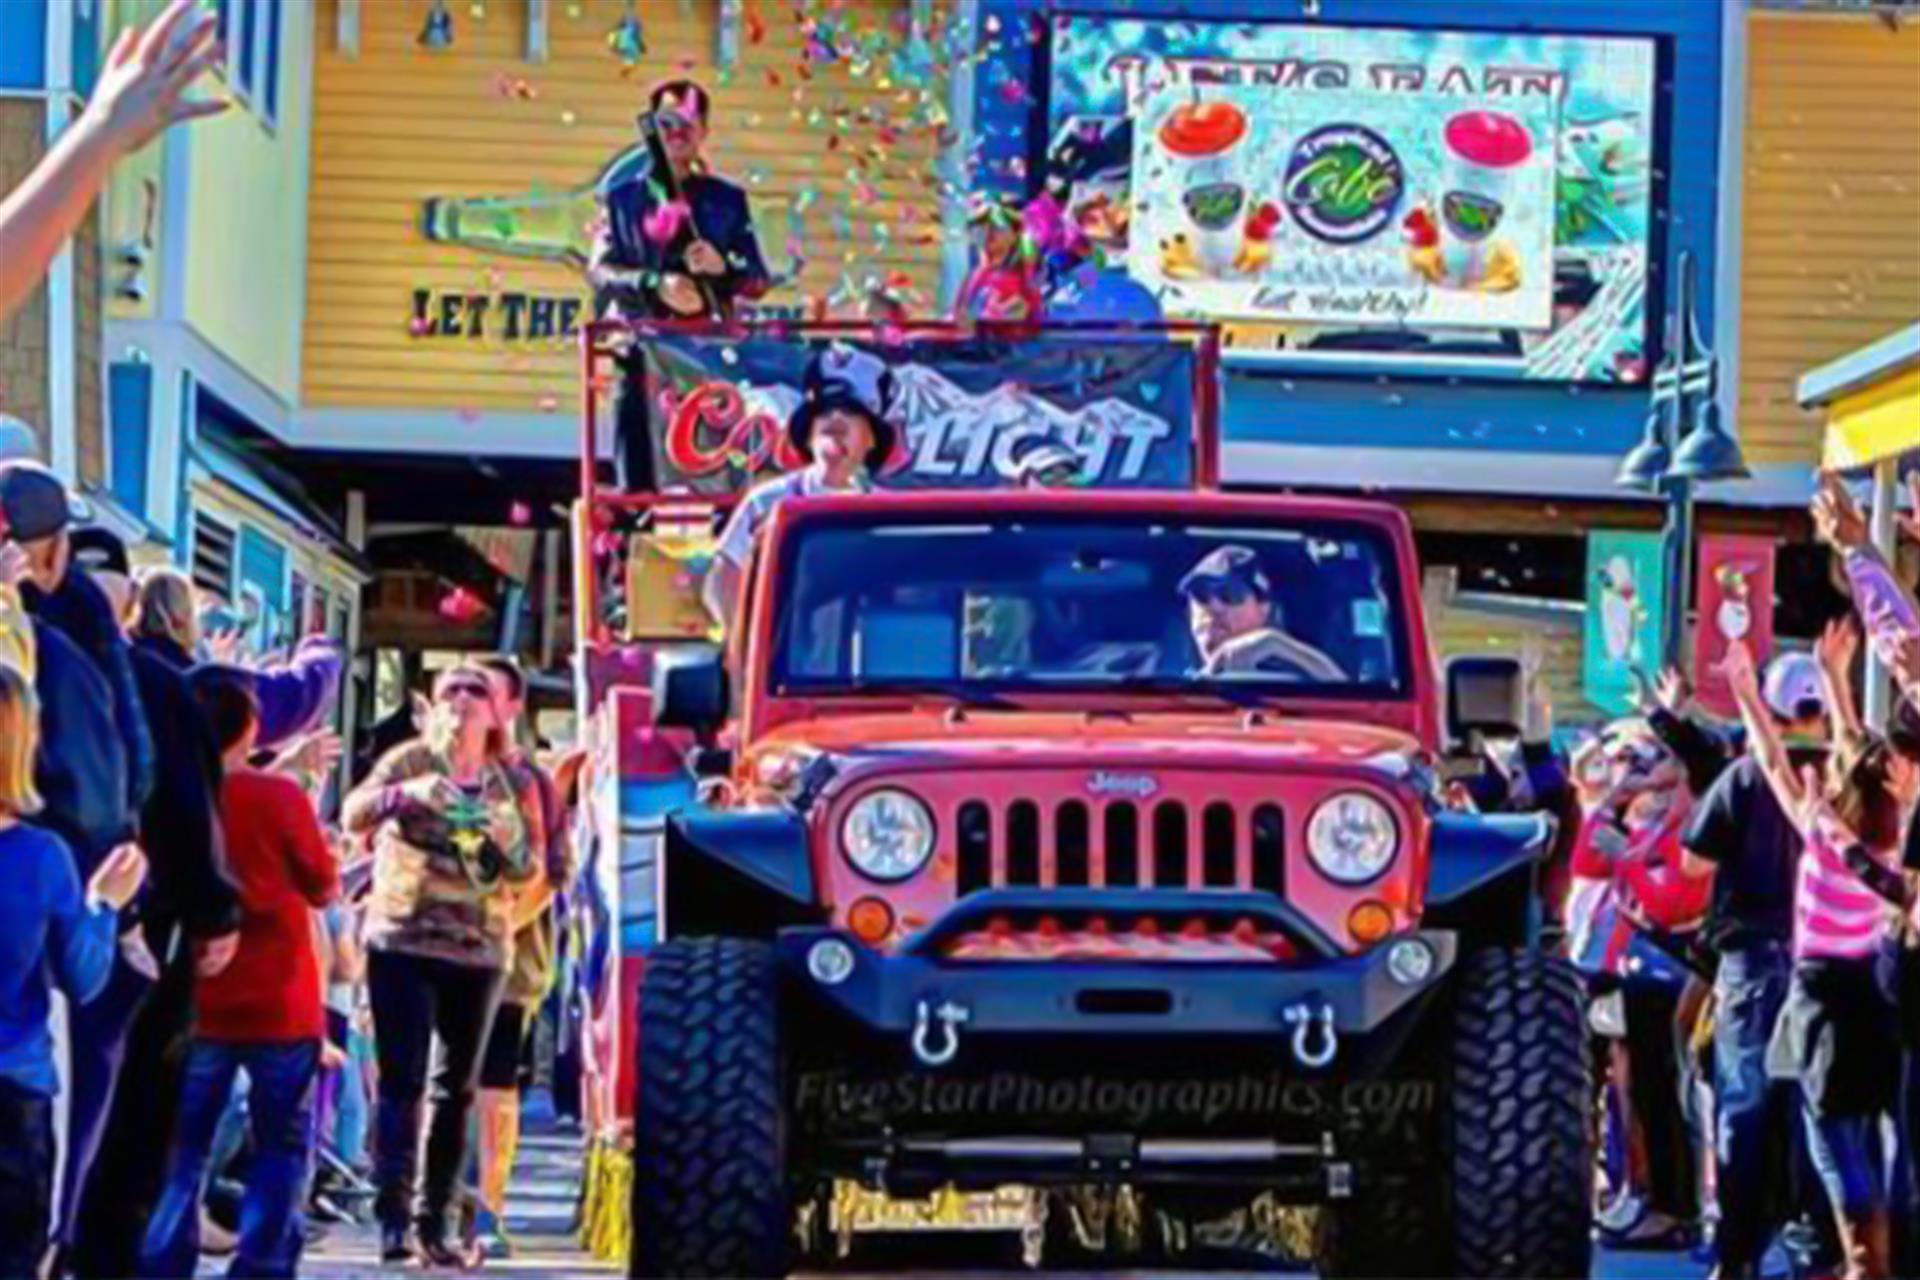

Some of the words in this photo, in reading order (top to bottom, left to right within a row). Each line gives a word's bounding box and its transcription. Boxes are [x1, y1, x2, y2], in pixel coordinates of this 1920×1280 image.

[409, 289, 491, 338] LET
[499, 292, 581, 339] THE
[1086, 771, 1158, 796] Jeep
